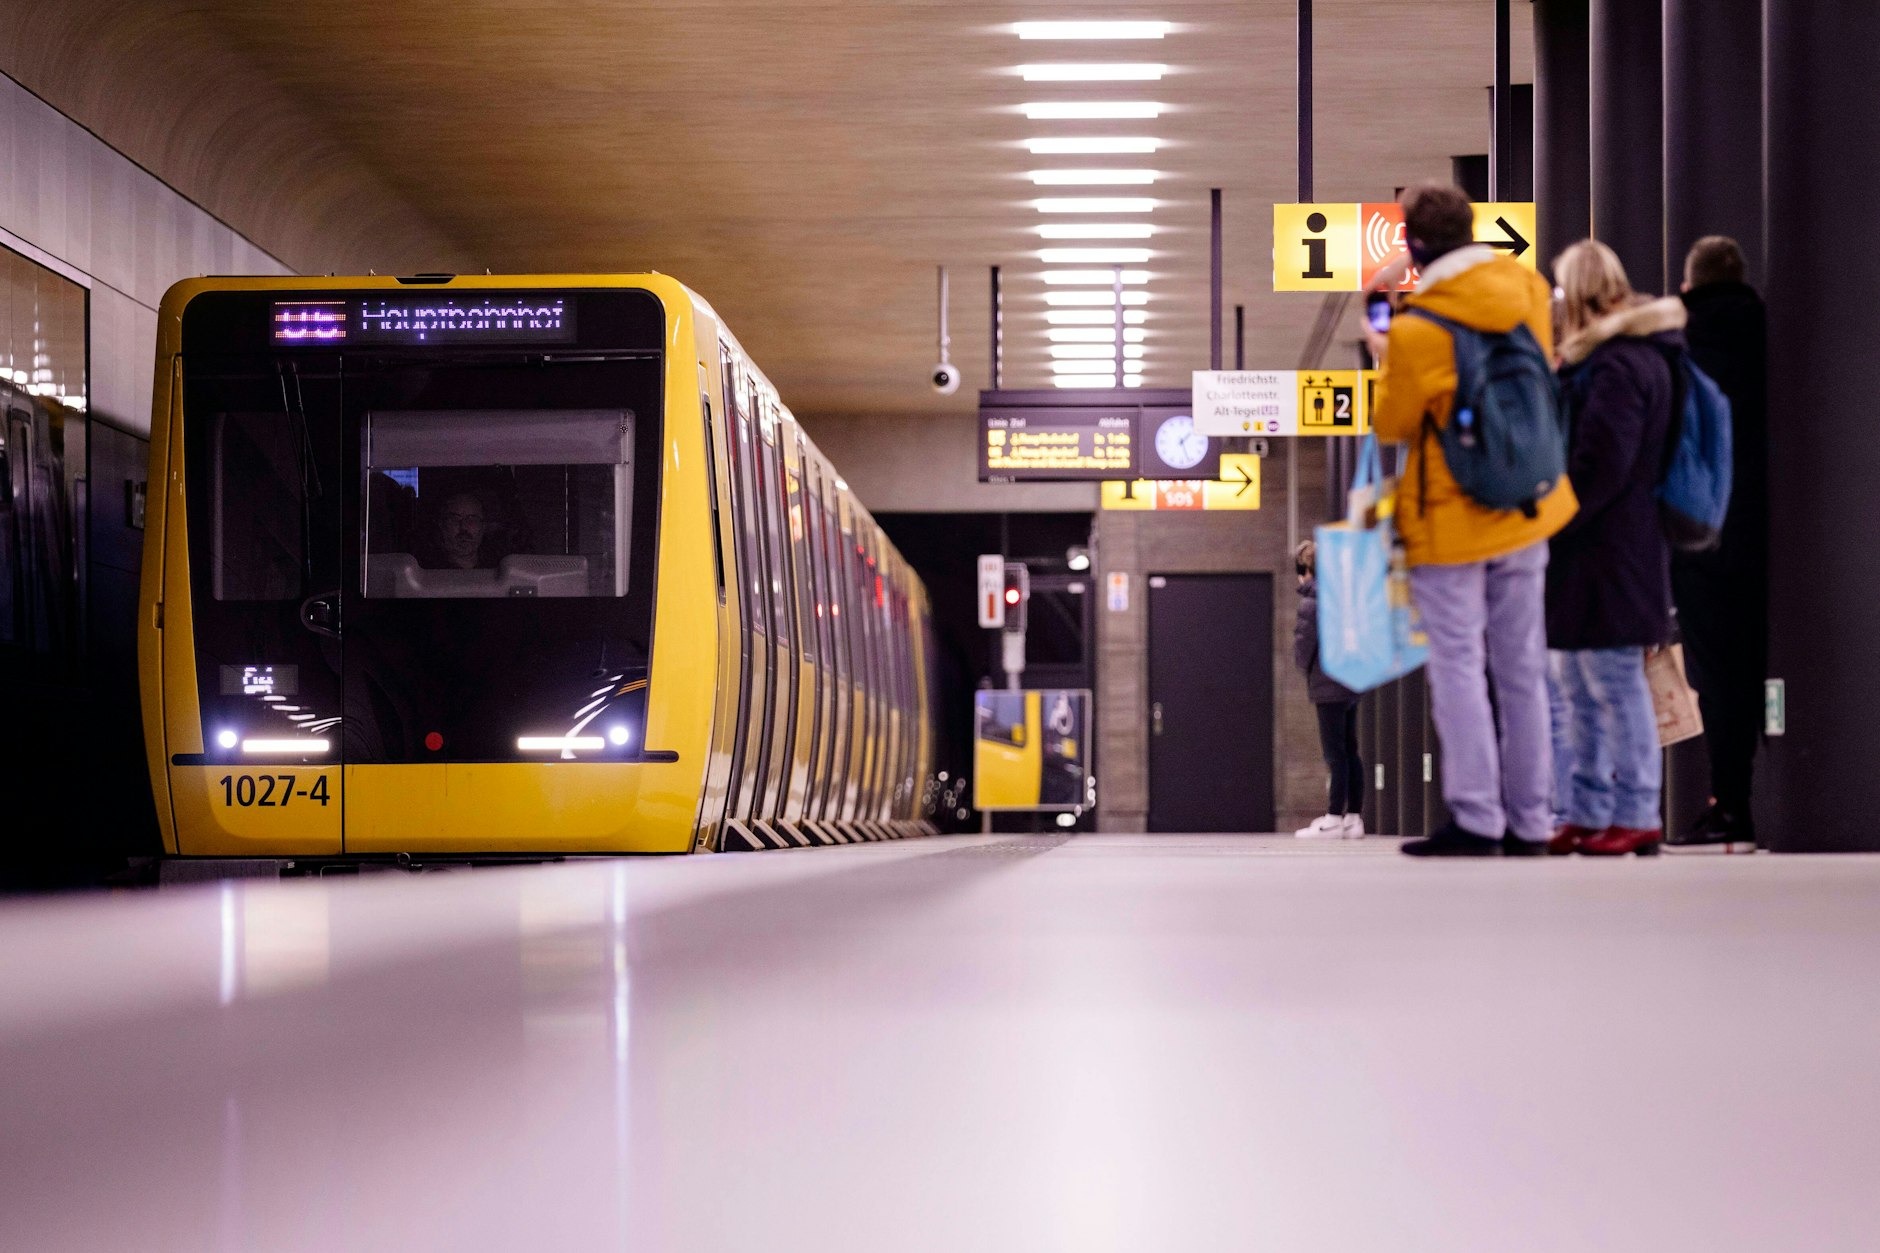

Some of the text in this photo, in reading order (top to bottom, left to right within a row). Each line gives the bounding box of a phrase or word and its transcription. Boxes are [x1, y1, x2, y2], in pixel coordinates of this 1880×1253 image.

[1217, 373, 1280, 385] Friedrichstr.
[1207, 389, 1280, 401] Charlottenstr.
[1214, 405, 1261, 417] Alt-Tegel
[1335, 393, 1351, 419] 2
[1165, 491, 1194, 507] SOS
[219, 774, 331, 807] 1027-4
